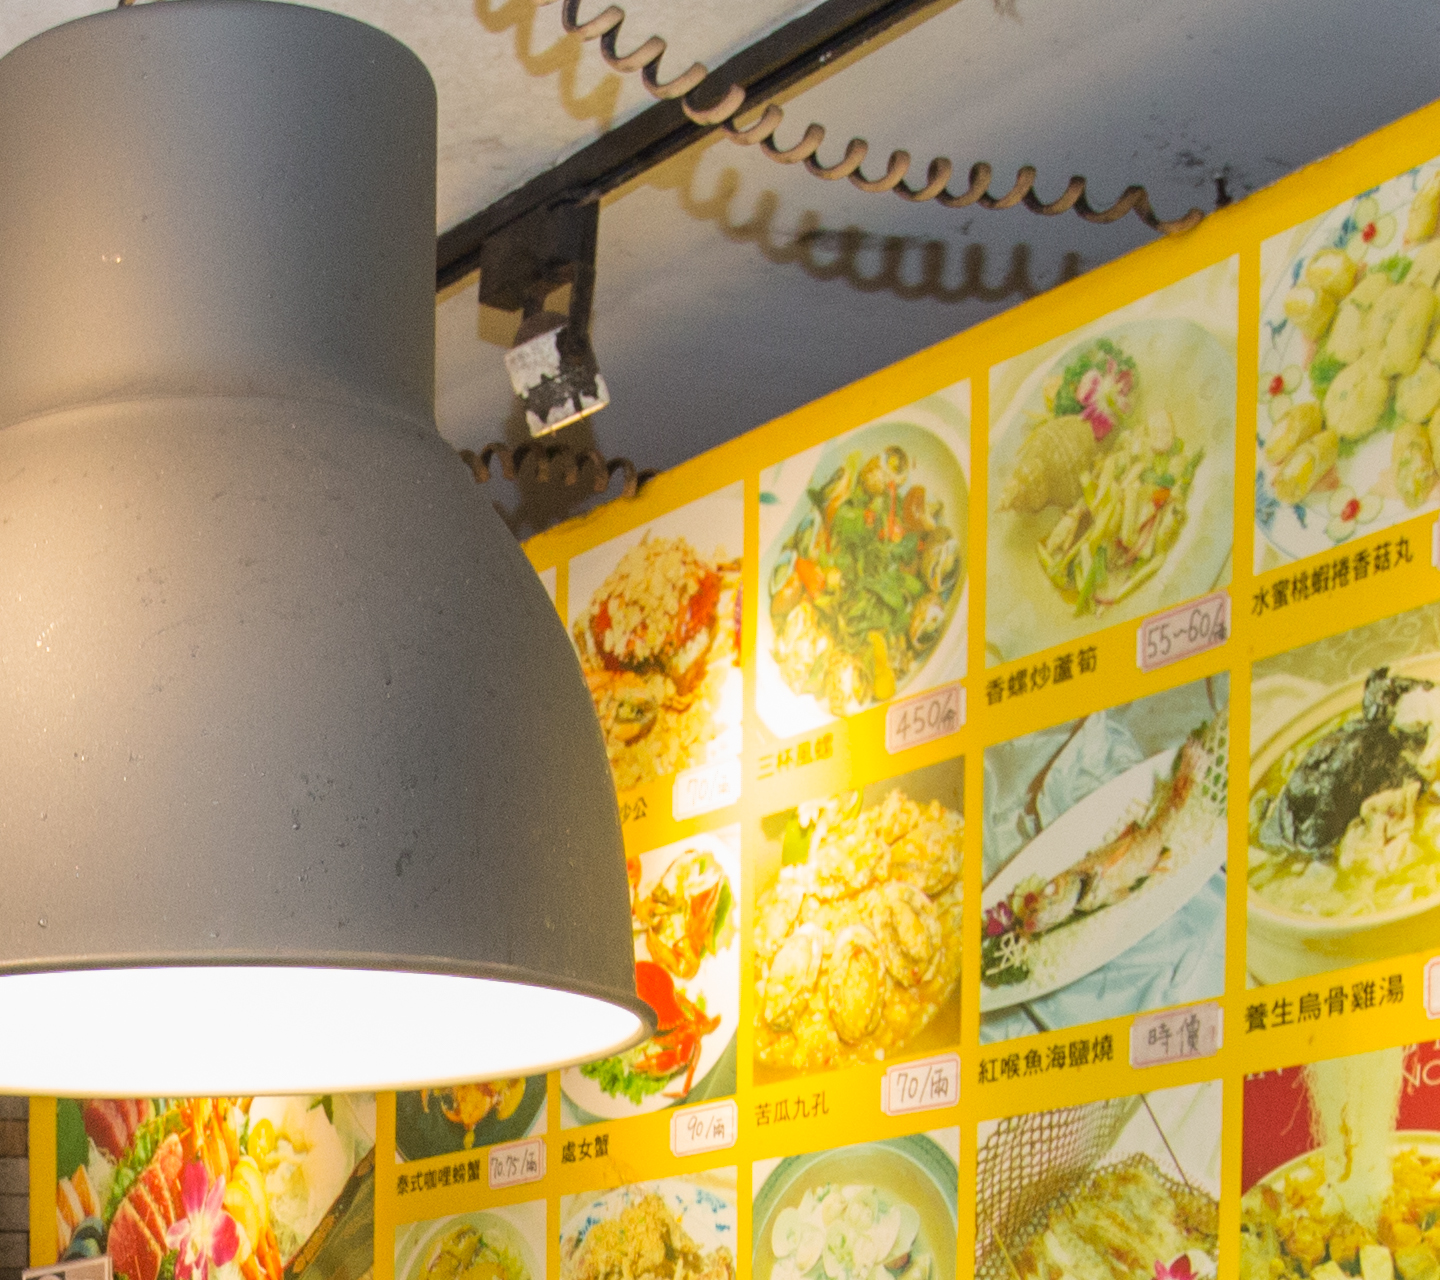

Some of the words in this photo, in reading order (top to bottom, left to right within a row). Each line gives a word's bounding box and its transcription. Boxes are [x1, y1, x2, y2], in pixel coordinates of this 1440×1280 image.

[1244, 975, 1406, 1034] 養生烏骨雞湯
[755, 1093, 830, 1127] 苦瓜九孔
